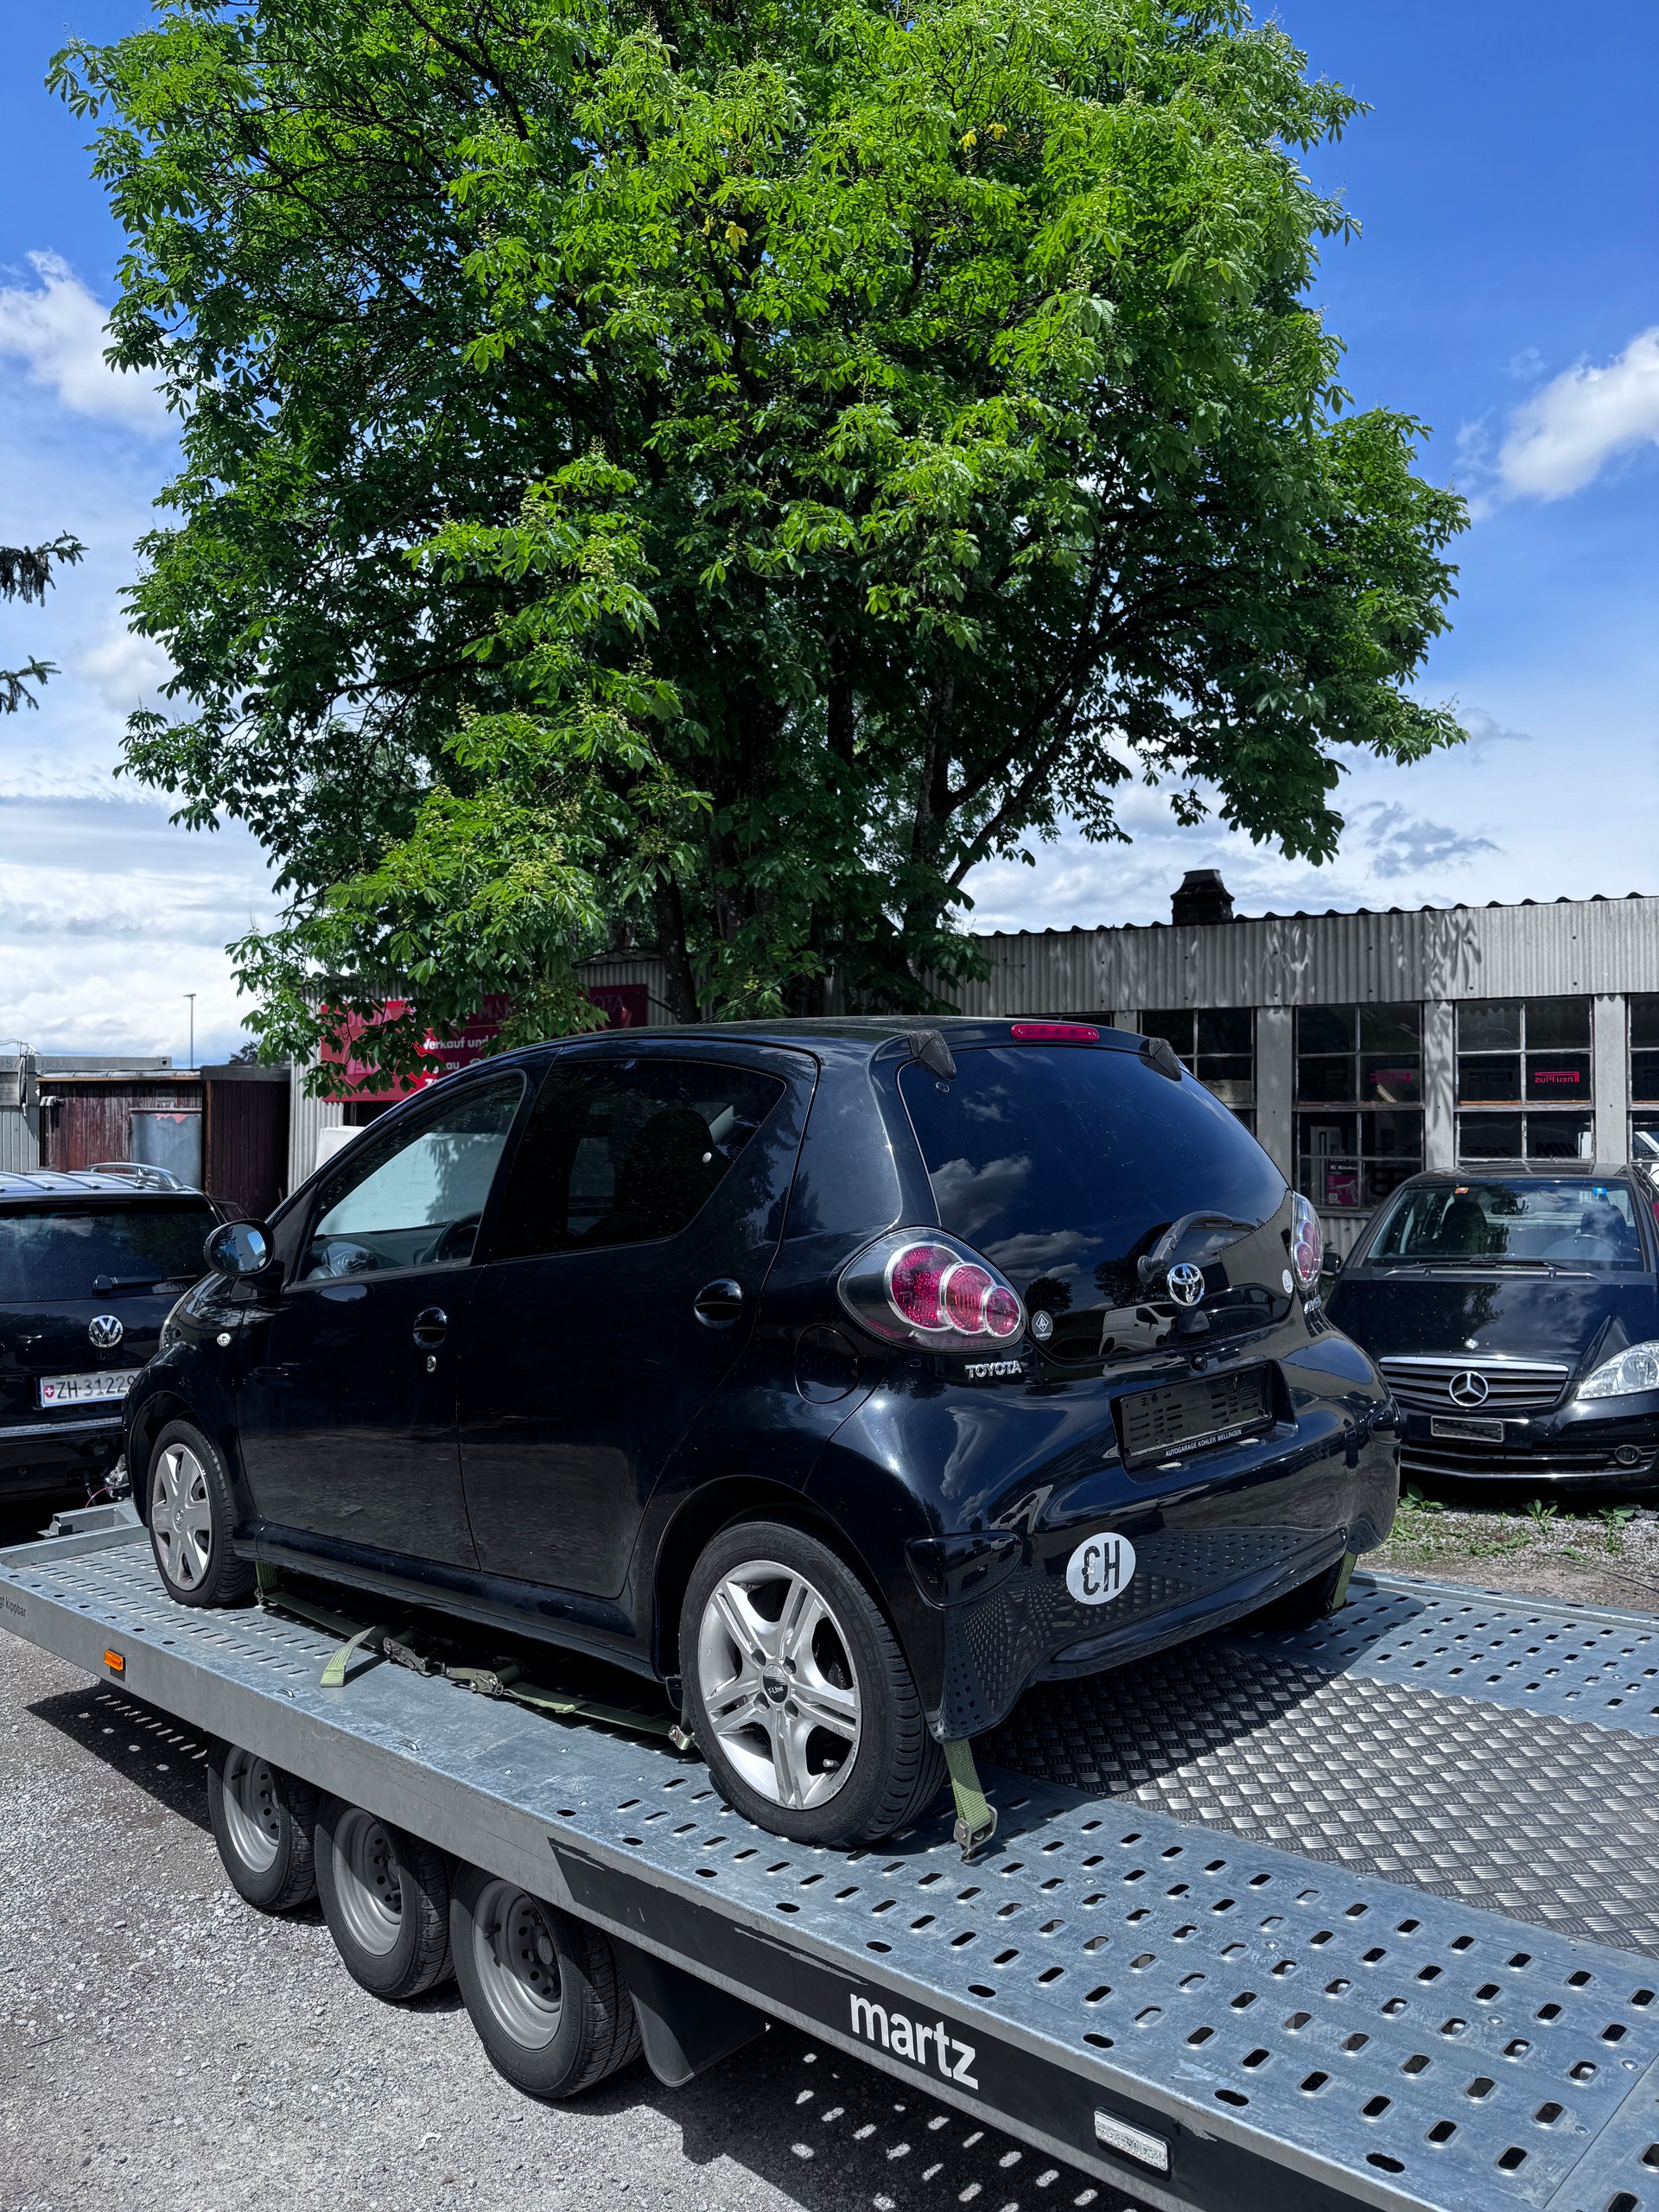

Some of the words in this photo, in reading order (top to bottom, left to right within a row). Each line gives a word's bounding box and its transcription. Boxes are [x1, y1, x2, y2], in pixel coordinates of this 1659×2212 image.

[964, 1360, 1022, 1379] TOYOTA
[1165, 1441, 1198, 1458] AUTOGARAGE
[1217, 1428, 1242, 1441] MELLINGEN
[1081, 1540, 1121, 1596] CH
[849, 1993, 979, 2091] martz
